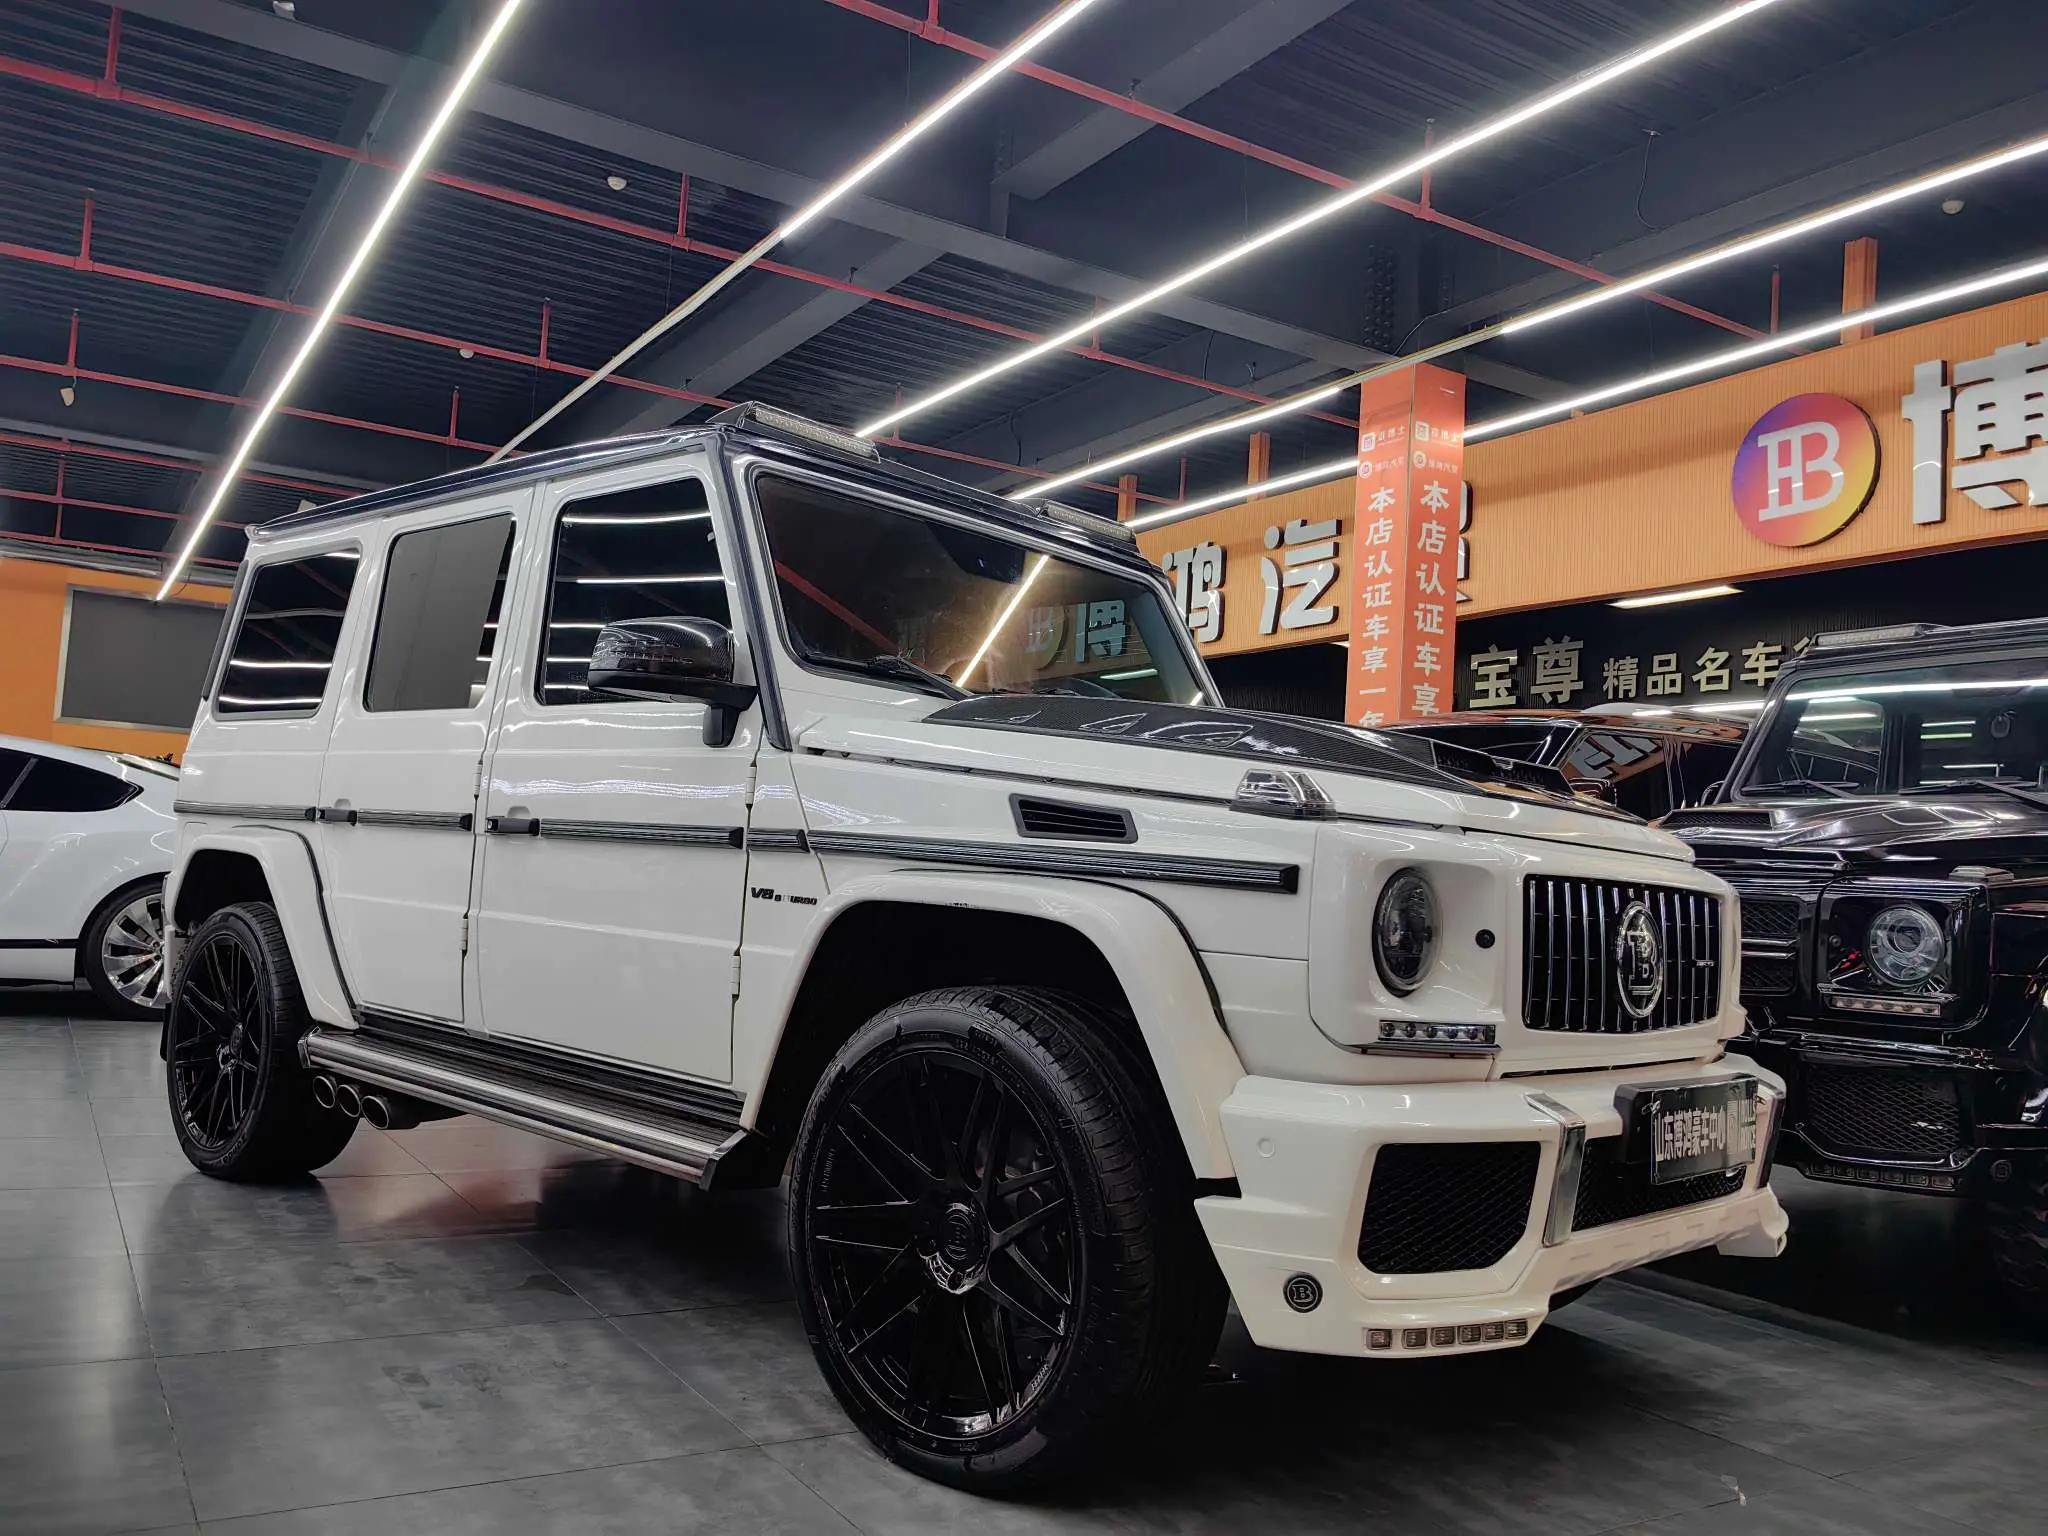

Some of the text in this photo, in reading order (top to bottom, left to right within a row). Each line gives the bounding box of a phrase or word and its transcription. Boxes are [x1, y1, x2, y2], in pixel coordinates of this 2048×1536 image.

[1412, 480, 1450, 717] 本店认证车享
[1469, 635, 1811, 709] 宝尊 精品名车
[750, 886, 775, 900] V8
